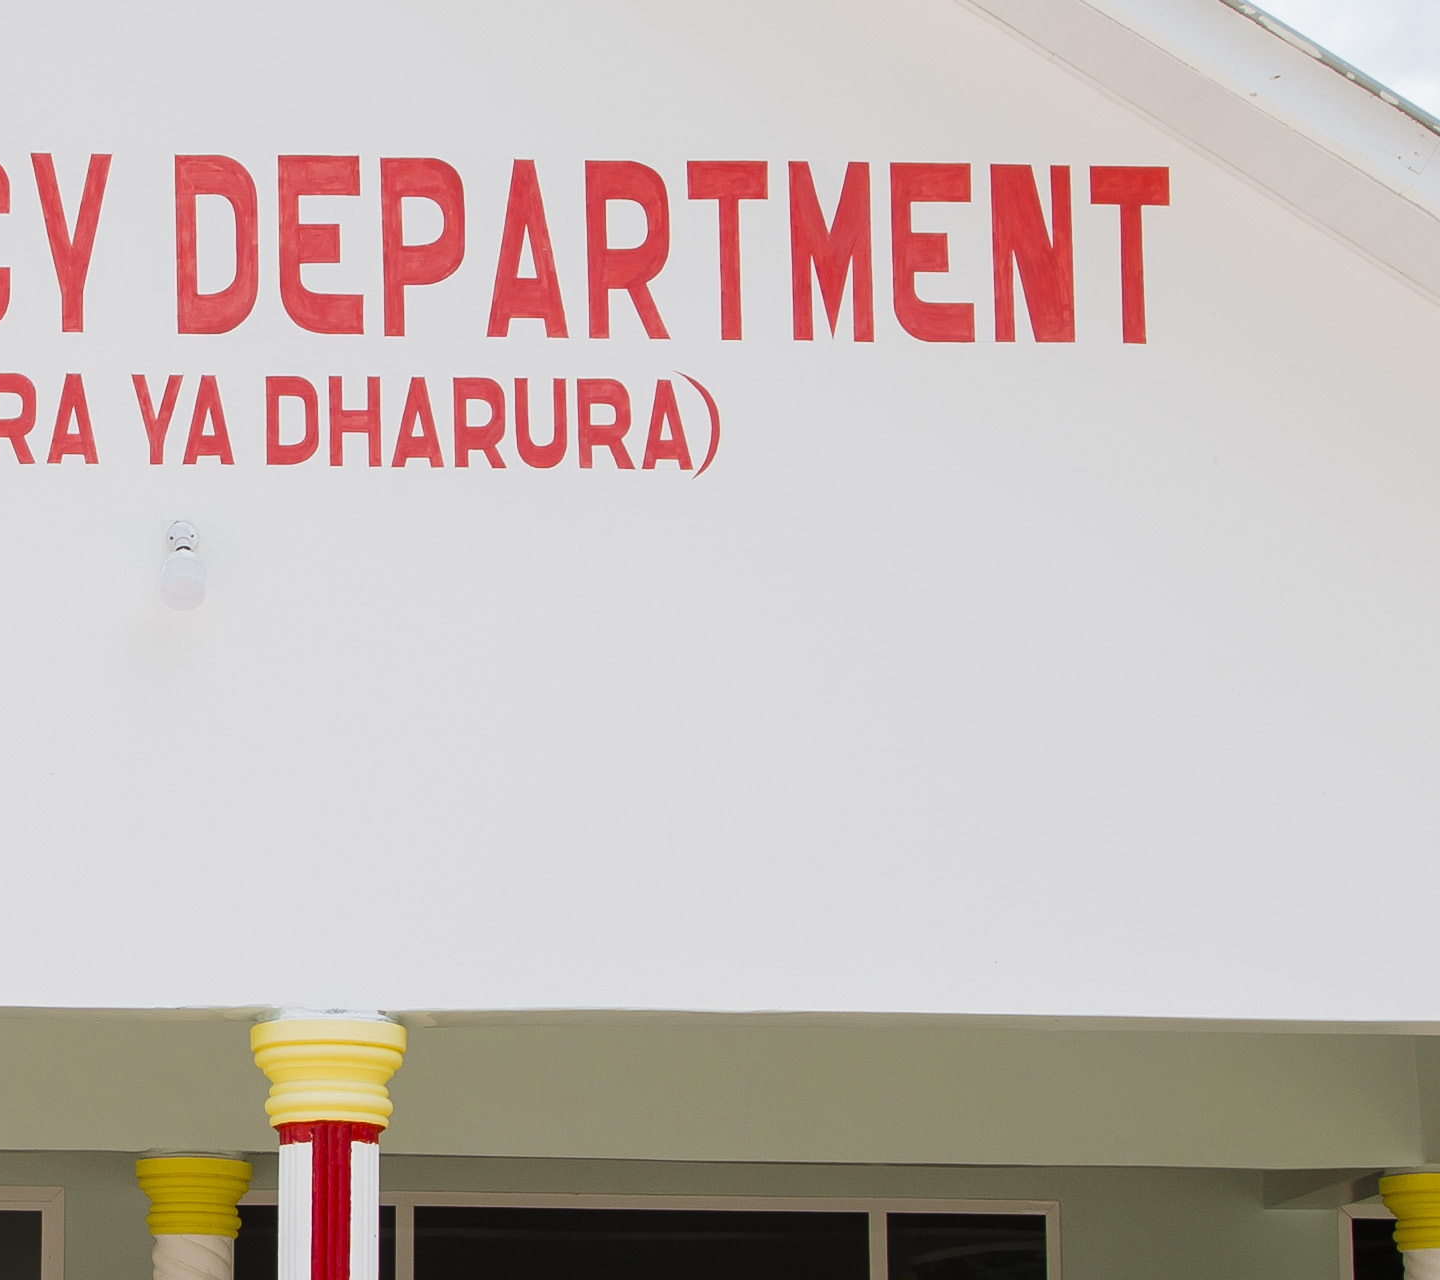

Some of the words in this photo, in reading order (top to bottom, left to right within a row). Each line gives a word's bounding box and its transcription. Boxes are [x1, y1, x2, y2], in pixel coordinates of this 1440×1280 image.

[173, 153, 1170, 344] DEPARTMENT
[130, 372, 235, 466] YA
[266, 370, 721, 480] DHARURA)
